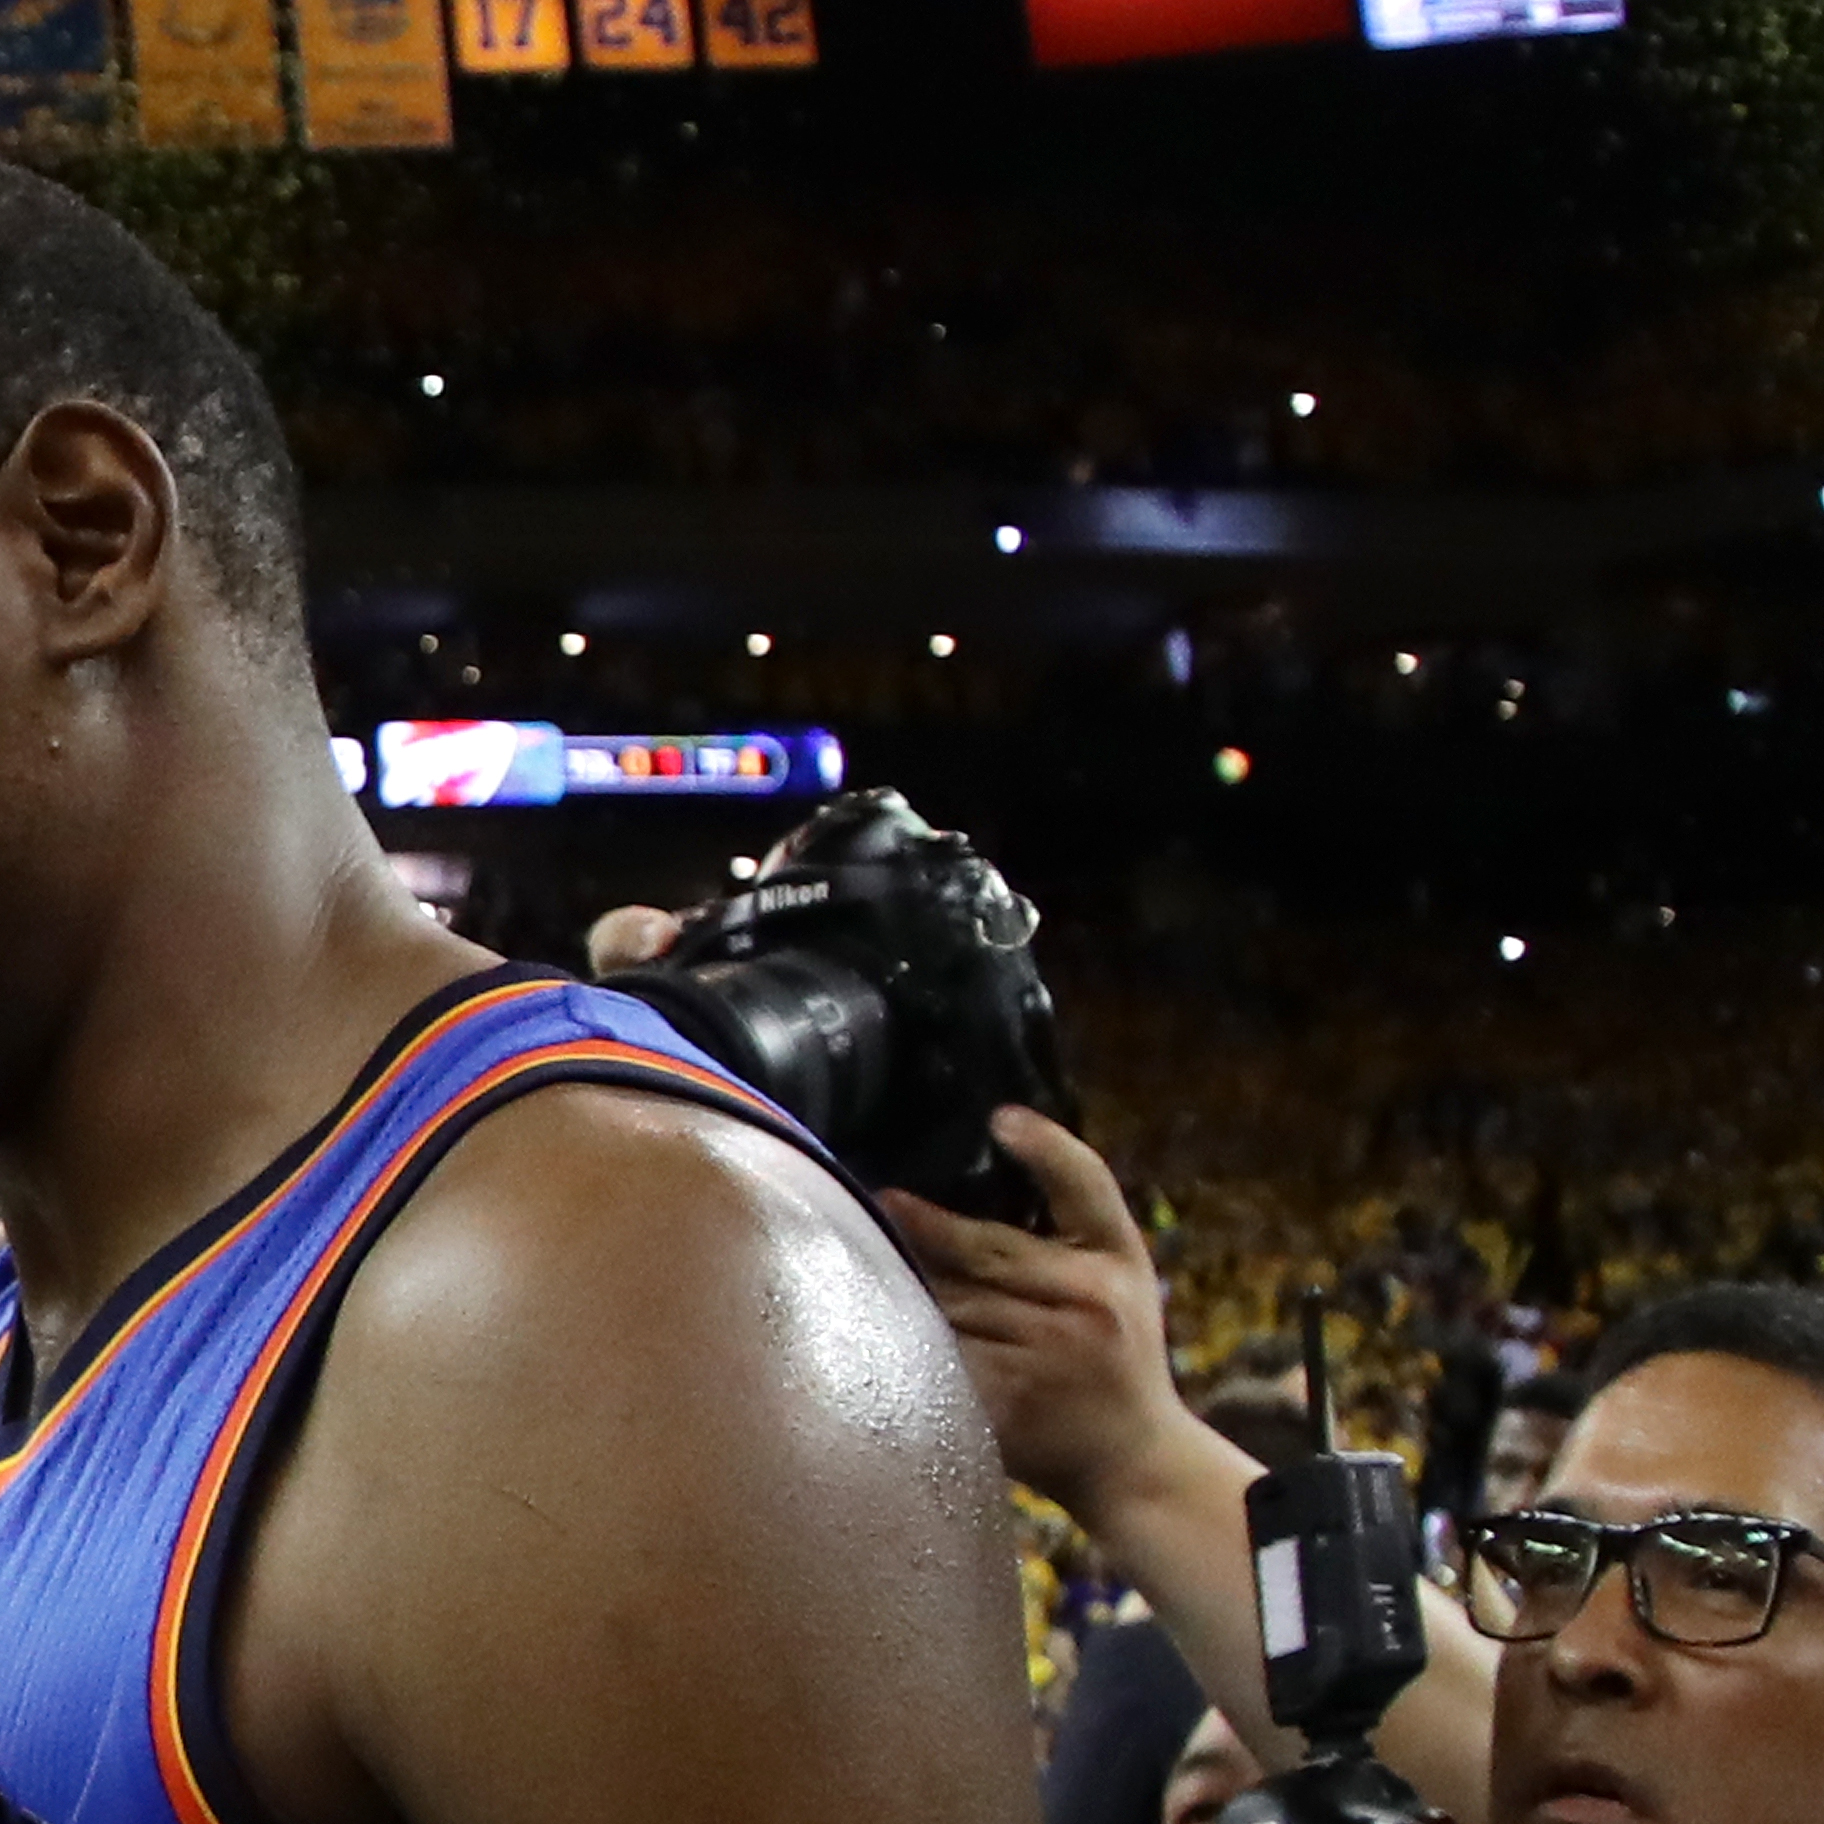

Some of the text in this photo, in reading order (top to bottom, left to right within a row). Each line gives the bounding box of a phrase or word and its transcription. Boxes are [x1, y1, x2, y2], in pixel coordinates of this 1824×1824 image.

[594, 0, 679, 47] 24
[718, 0, 801, 46] 42
[759, 881, 830, 914] Nikon
